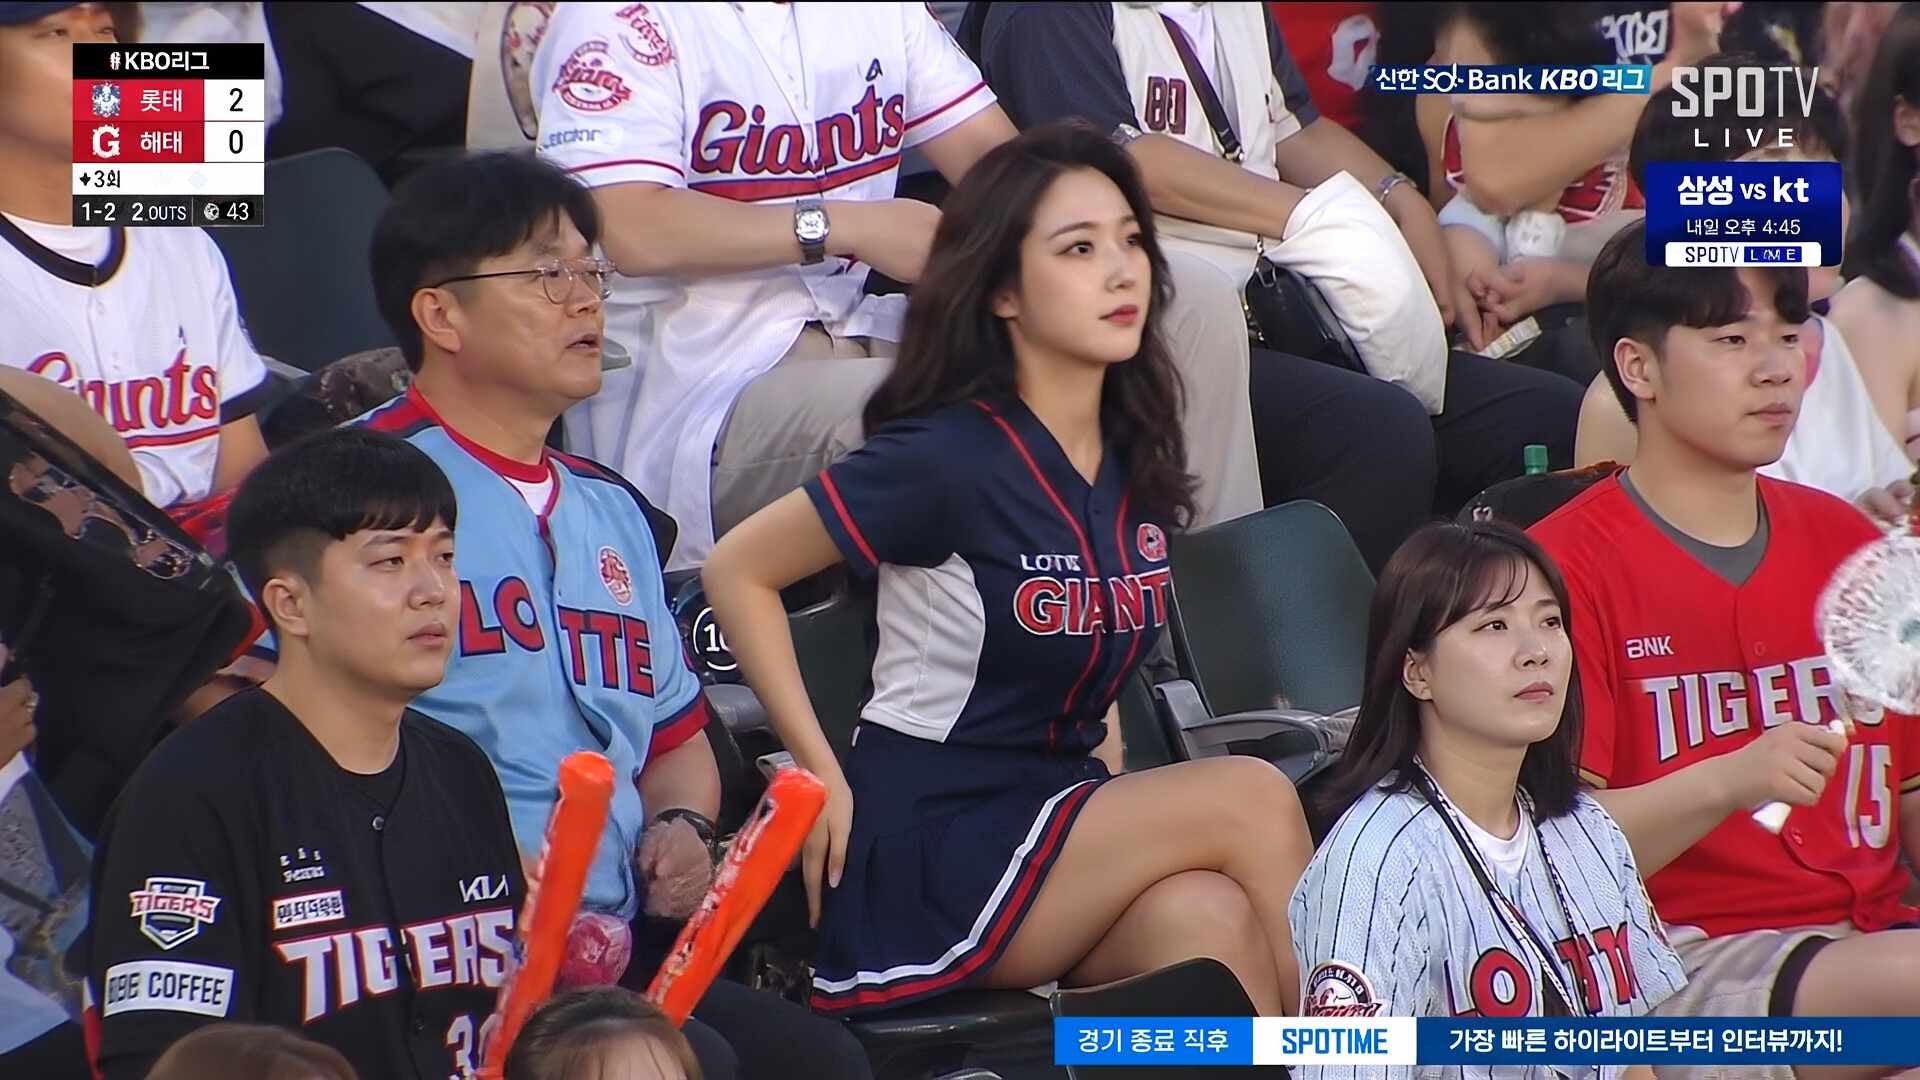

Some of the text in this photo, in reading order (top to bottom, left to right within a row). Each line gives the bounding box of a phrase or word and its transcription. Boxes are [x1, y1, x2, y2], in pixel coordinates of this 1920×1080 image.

[691, 84, 904, 175] Giants
[1625, 635, 1674, 659] BNK
[1640, 654, 1885, 764] TIGER
[1844, 743, 1892, 849] 15
[131, 894, 214, 919] TIGERS
[149, 971, 226, 1006] COFFEE
